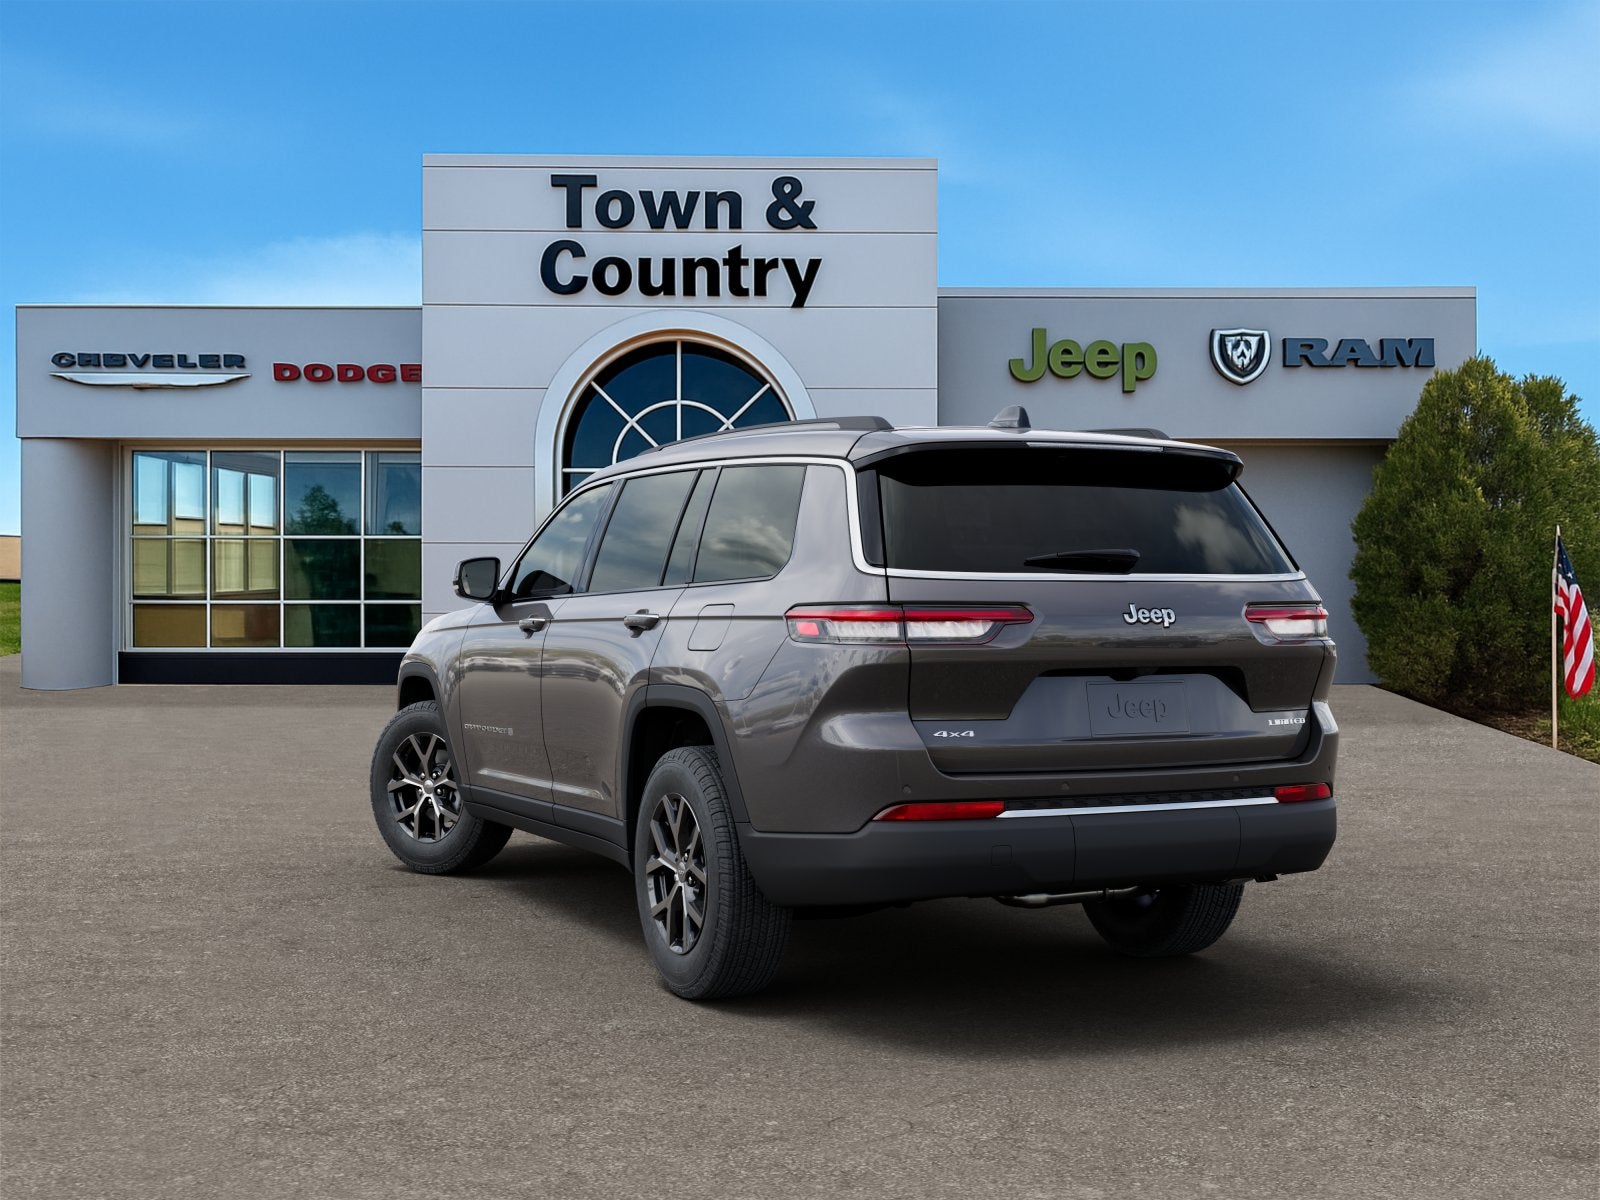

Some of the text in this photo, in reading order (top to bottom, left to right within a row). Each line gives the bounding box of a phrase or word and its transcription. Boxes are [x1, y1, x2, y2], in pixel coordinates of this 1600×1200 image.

[550, 174, 818, 230] Town &
[540, 239, 823, 308] Country
[1008, 327, 1158, 393] Jeep
[1282, 337, 1436, 368] RAM
[272, 363, 422, 383] DODGE
[1122, 602, 1177, 628] Jeep
[1107, 692, 1168, 723] Jeep
